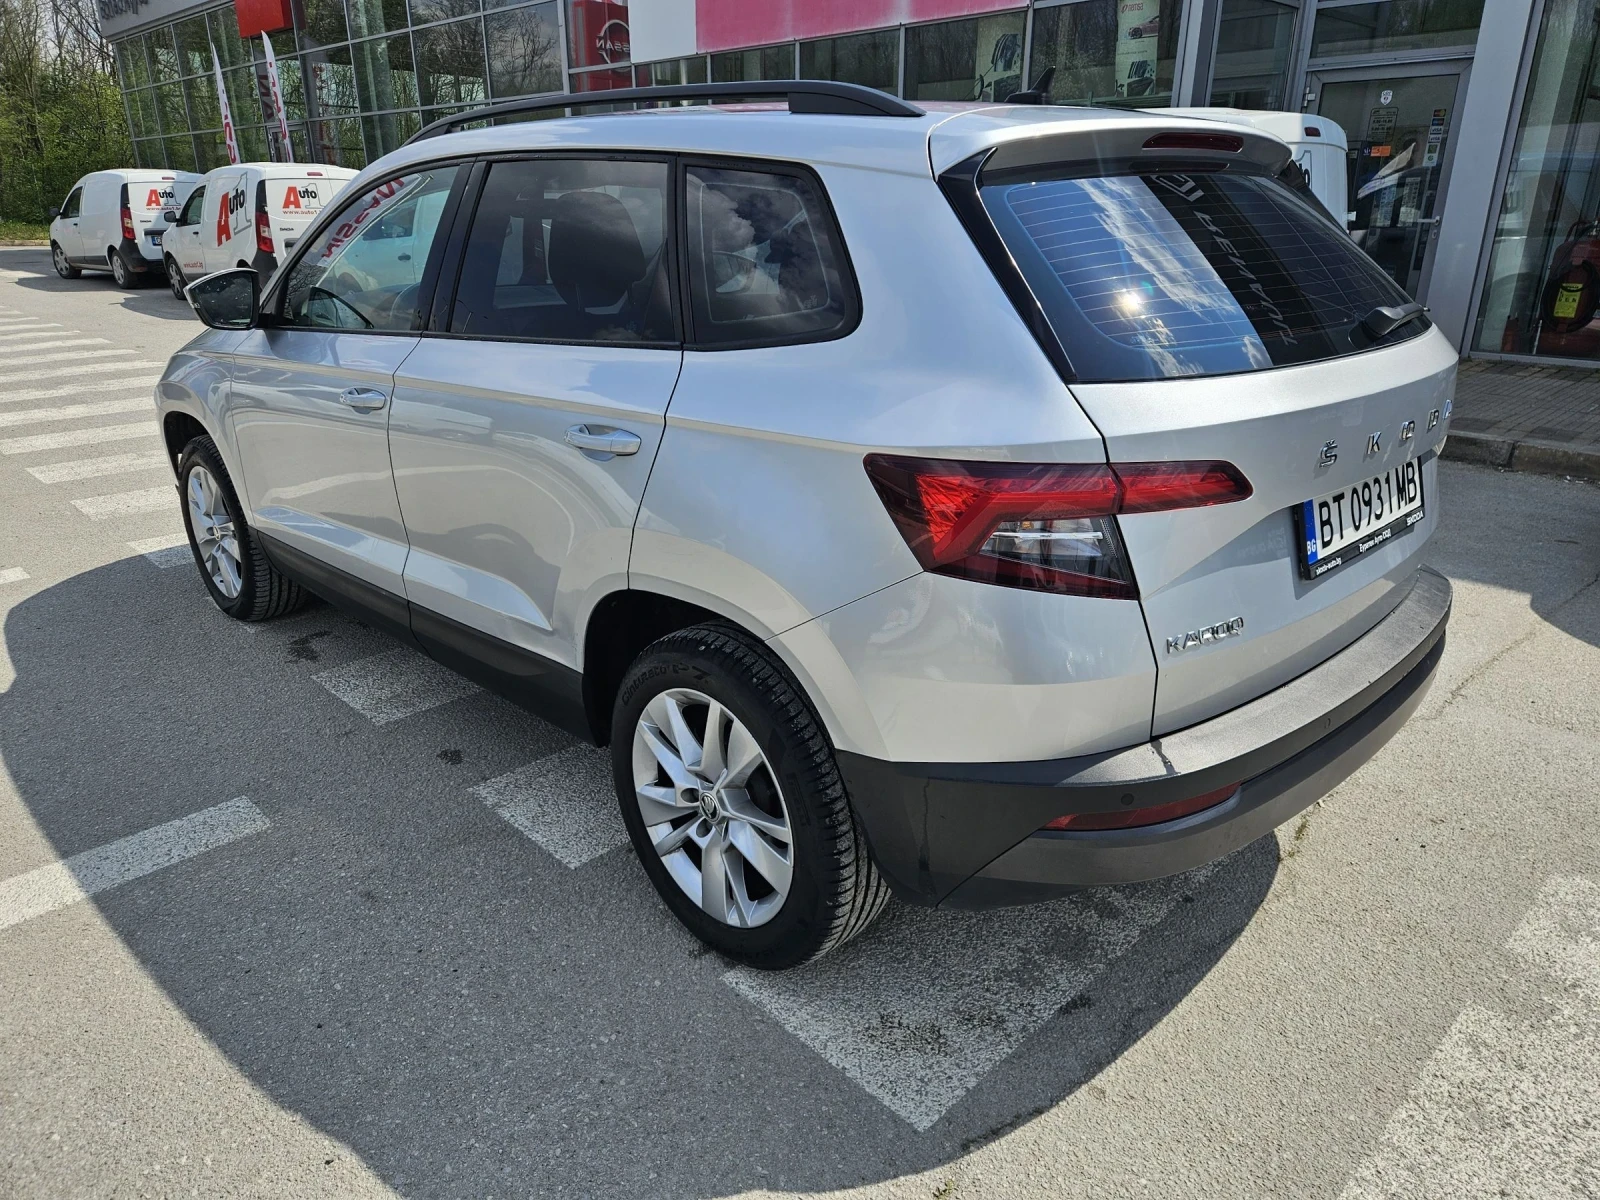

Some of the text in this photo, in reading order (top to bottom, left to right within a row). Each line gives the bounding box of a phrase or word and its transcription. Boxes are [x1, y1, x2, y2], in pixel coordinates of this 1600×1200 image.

[1318, 461, 1418, 550] BT 0931 MB
[1306, 538, 1317, 556] BG
[1166, 616, 1244, 655] KAROQ
